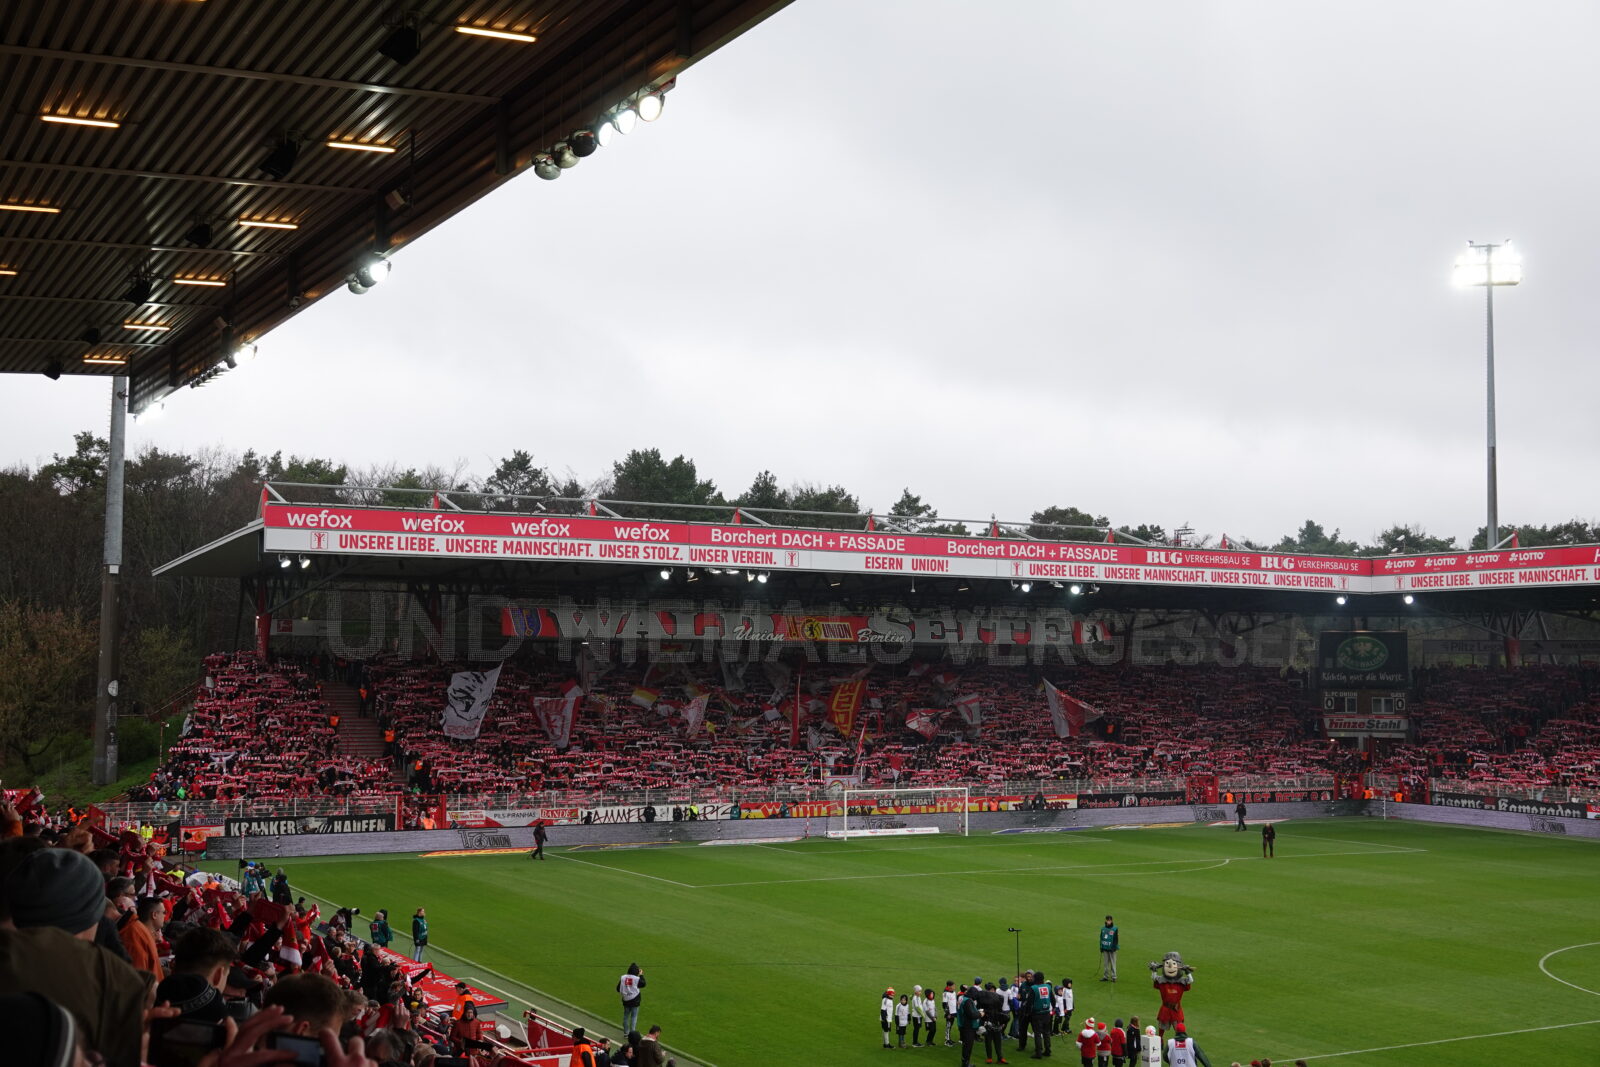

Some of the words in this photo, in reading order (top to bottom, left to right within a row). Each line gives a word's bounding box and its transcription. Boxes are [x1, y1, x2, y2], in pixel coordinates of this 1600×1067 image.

[286, 509, 352, 528] wefox
[401, 514, 465, 533] wefox
[511, 519, 570, 537] wefox
[614, 524, 670, 541] wefox
[711, 528, 777, 546] Borchert
[782, 532, 823, 548] DACH
[827, 539, 836, 548] +
[839, 535, 905, 551] FASSADE
[339, 534, 394, 551] UNSERE
[397, 536, 440, 552] LIEBE.
[445, 538, 498, 554] UNSERE
[502, 540, 594, 559] MANNSCHAFT.
[599, 544, 640, 559] UNSER
[643, 546, 683, 561] STOLZ.
[690, 548, 728, 562] UNSER
[732, 549, 777, 566] VEREIN.
[947, 541, 1005, 557] Borchert
[1009, 544, 1046, 559] DACH
[1048, 550, 1057, 558] +
[1059, 546, 1118, 561] FASSADE
[1146, 550, 1182, 564] BUG
[1184, 554, 1240, 565] VERKEHRSBAU
[1241, 556, 1250, 566] SE
[1519, 552, 1544, 562] LOTTO
[864, 555, 903, 570] EISERN
[911, 558, 949, 572] UNION!
[1260, 556, 1295, 570] BUG
[1297, 560, 1349, 571] VERKEHRSBAU
[1350, 562, 1359, 571] SE
[1393, 559, 1415, 569] LOTTO
[1433, 557, 1456, 567] LOTTO
[1475, 555, 1499, 564] LOTTO
[1029, 563, 1067, 577] UNSERE
[1068, 565, 1099, 578] LIEBE.
[1104, 566, 1141, 580] UNSERE
[1143, 568, 1208, 582] MANNSCHAFT.
[1210, 572, 1240, 584] UNSER
[1241, 573, 1271, 585] STOLZ.
[1274, 574, 1302, 587] UNSER
[1303, 575, 1336, 588] VEREIN.
[1411, 575, 1444, 588] UNSERE
[1446, 574, 1473, 587] LIEBE.
[1479, 572, 1515, 585] UNSERE
[1518, 568, 1588, 584] MANNSCHAFT.
[327, 590, 524, 662] UND
[733, 625, 784, 641] Union
[857, 628, 906, 643] Berlin
[822, 622, 851, 639] UNION
[541, 809, 571, 819] BANDE
[230, 820, 297, 837] KRANKER
